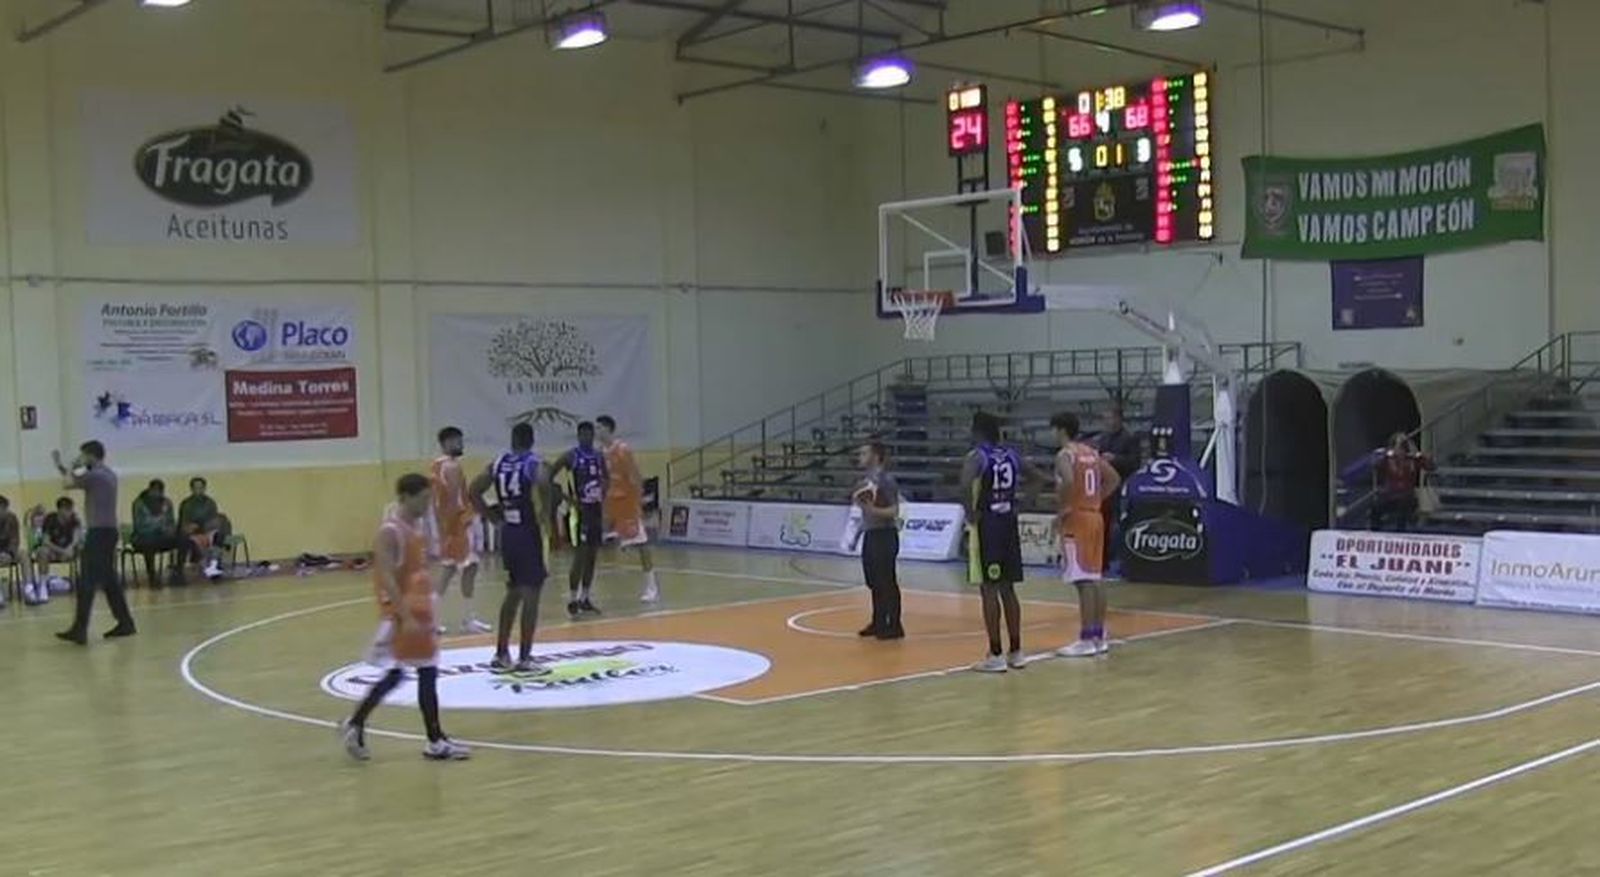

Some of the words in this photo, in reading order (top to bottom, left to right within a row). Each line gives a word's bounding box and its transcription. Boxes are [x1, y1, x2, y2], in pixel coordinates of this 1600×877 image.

[951, 114, 982, 149] 24
[1069, 115, 1091, 137] 66
[1126, 104, 1148, 129] 68
[144, 134, 301, 195] Fragata
[1298, 171, 1368, 201] VAMOS
[1371, 169, 1395, 197] MI
[1399, 156, 1471, 195] MORÓN
[167, 213, 289, 241] Aceitunas
[1298, 211, 1367, 243] VAMOS
[1372, 197, 1475, 240] CAMPEÓN
[101, 302, 157, 317] Antonio
[281, 321, 349, 346] Placo
[232, 381, 292, 395] Medina
[299, 381, 349, 394] Torres
[507, 381, 523, 394] LA
[499, 473, 521, 497] 14
[992, 462, 1013, 489] 13
[1085, 469, 1095, 496] 0
[1131, 524, 1197, 553] Fragata
[1336, 539, 1462, 559] OPORTUNIDADES
